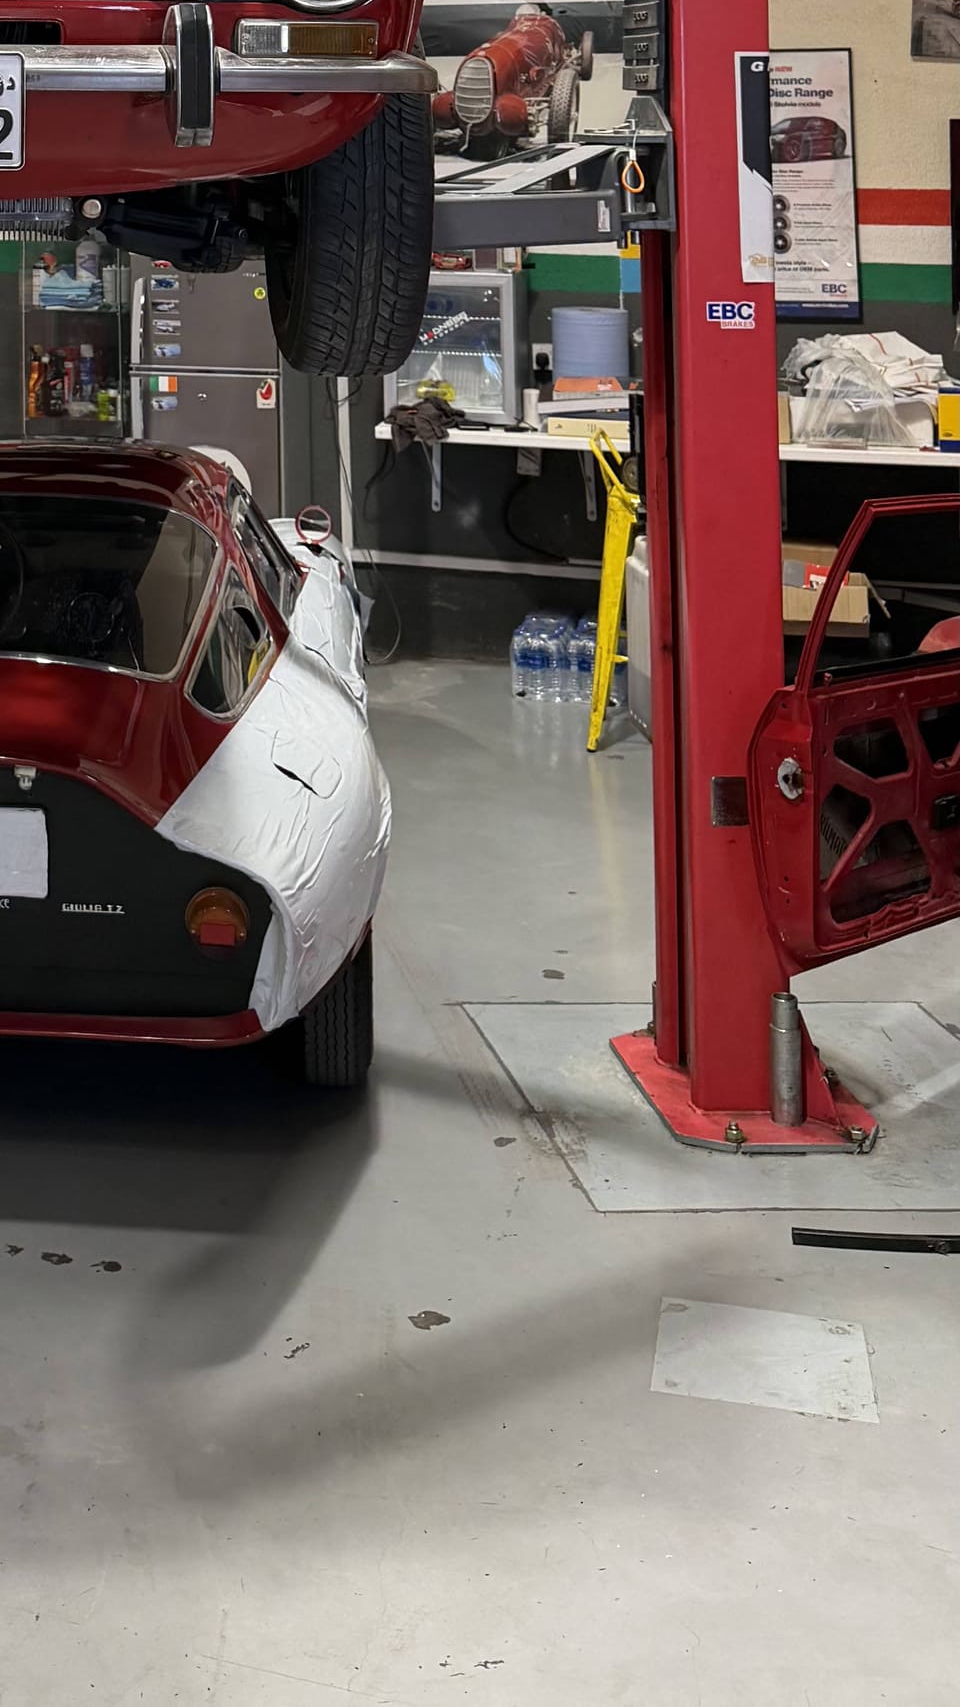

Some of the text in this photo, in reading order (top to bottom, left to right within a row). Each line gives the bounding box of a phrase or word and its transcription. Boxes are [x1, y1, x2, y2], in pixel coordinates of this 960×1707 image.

[769, 77, 812, 85] mance
[794, 88, 834, 99] Range
[821, 283, 848, 294] EBC
[707, 302, 754, 320] EBC
[721, 320, 754, 328] BRAKES
[62, 903, 103, 912] GIULIA
